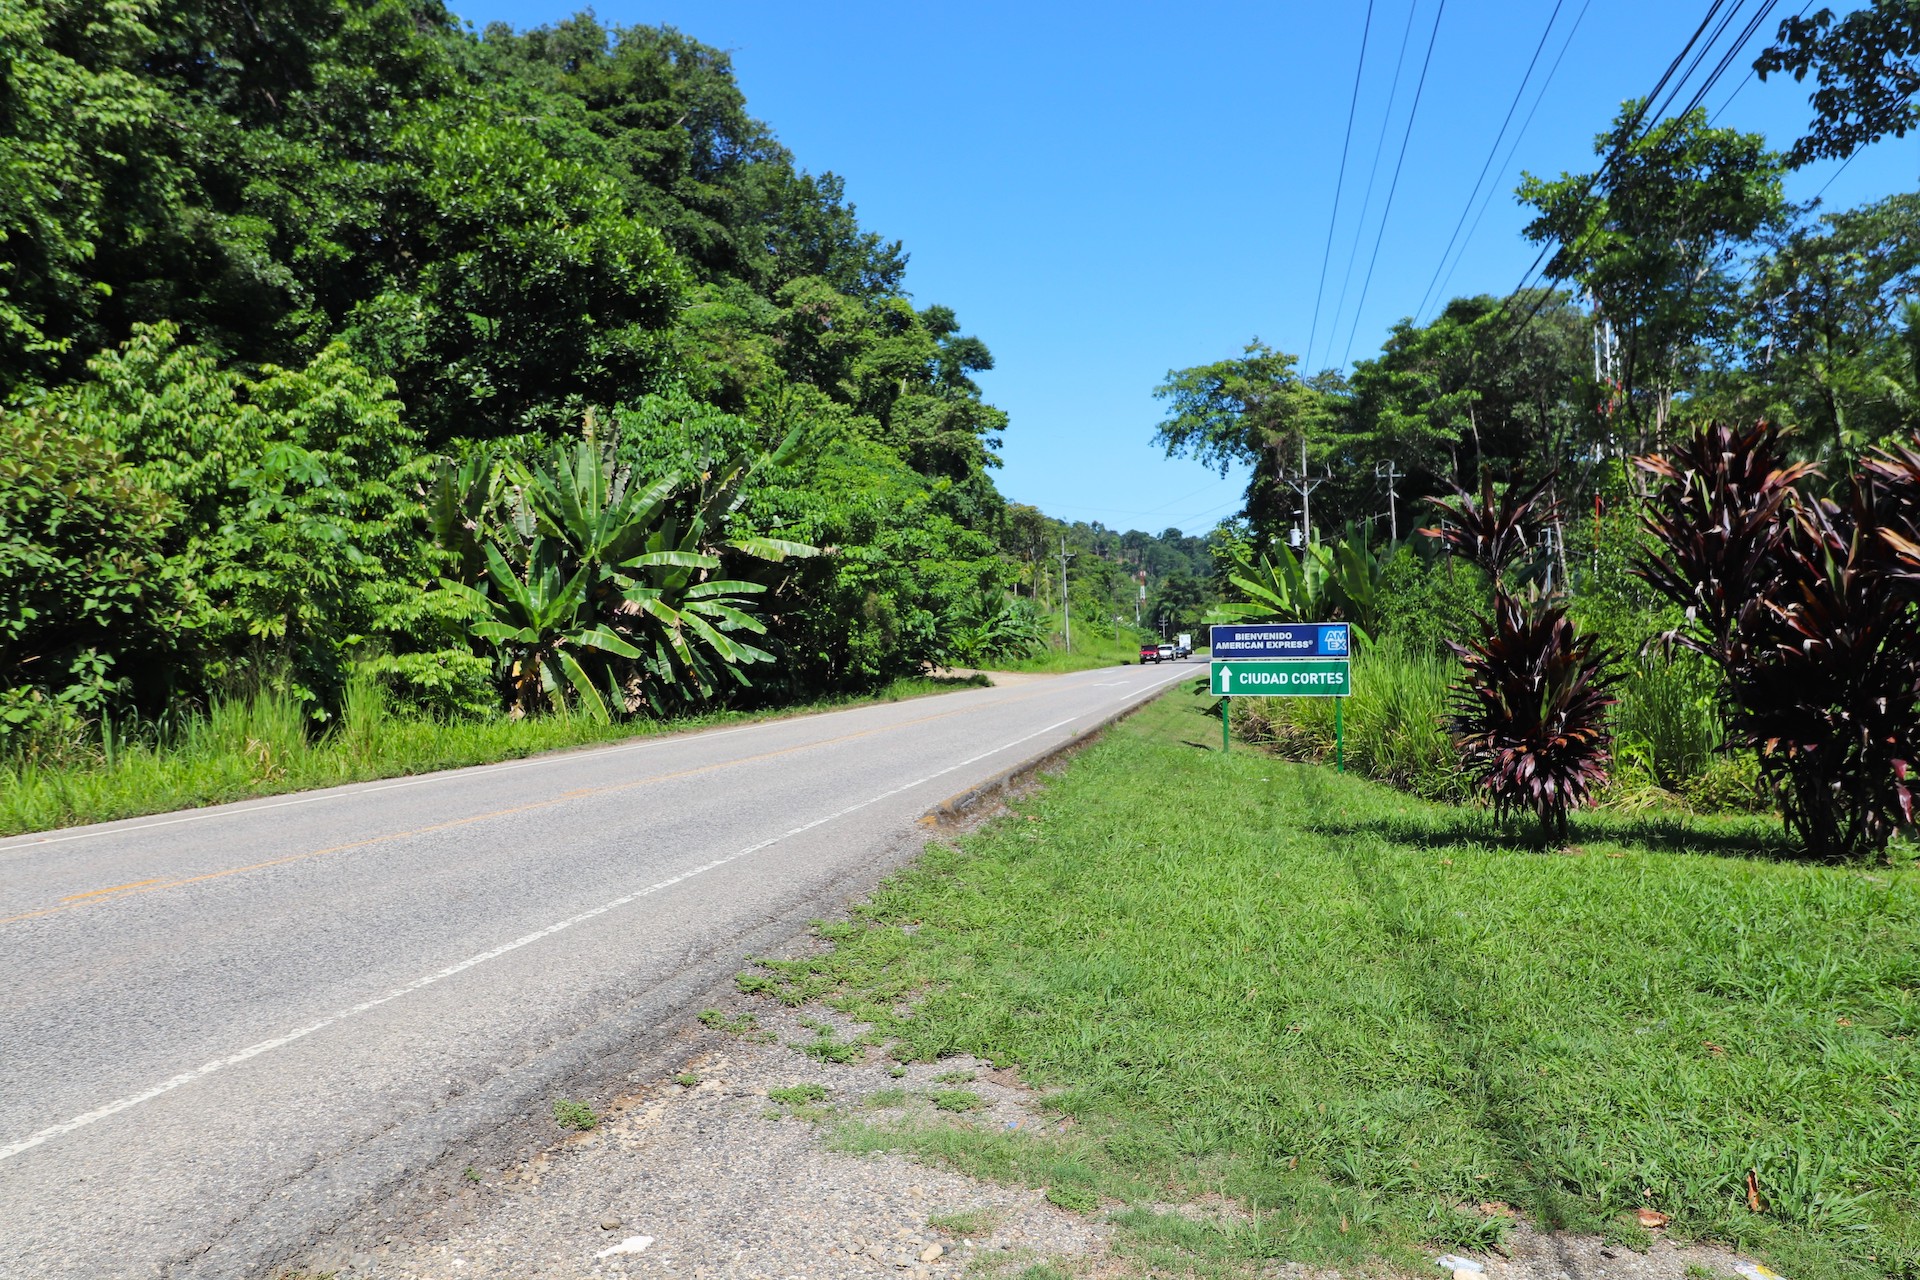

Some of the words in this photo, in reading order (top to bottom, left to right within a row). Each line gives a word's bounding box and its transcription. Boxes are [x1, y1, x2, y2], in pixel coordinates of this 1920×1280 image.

[1235, 632, 1292, 641] BIENVENIDO
[1324, 630, 1346, 642] AM
[1216, 640, 1264, 650] AMERICAN
[1327, 640, 1347, 651] EX
[1239, 672, 1288, 684] CIUDAD
[1291, 672, 1344, 684] CORTES
